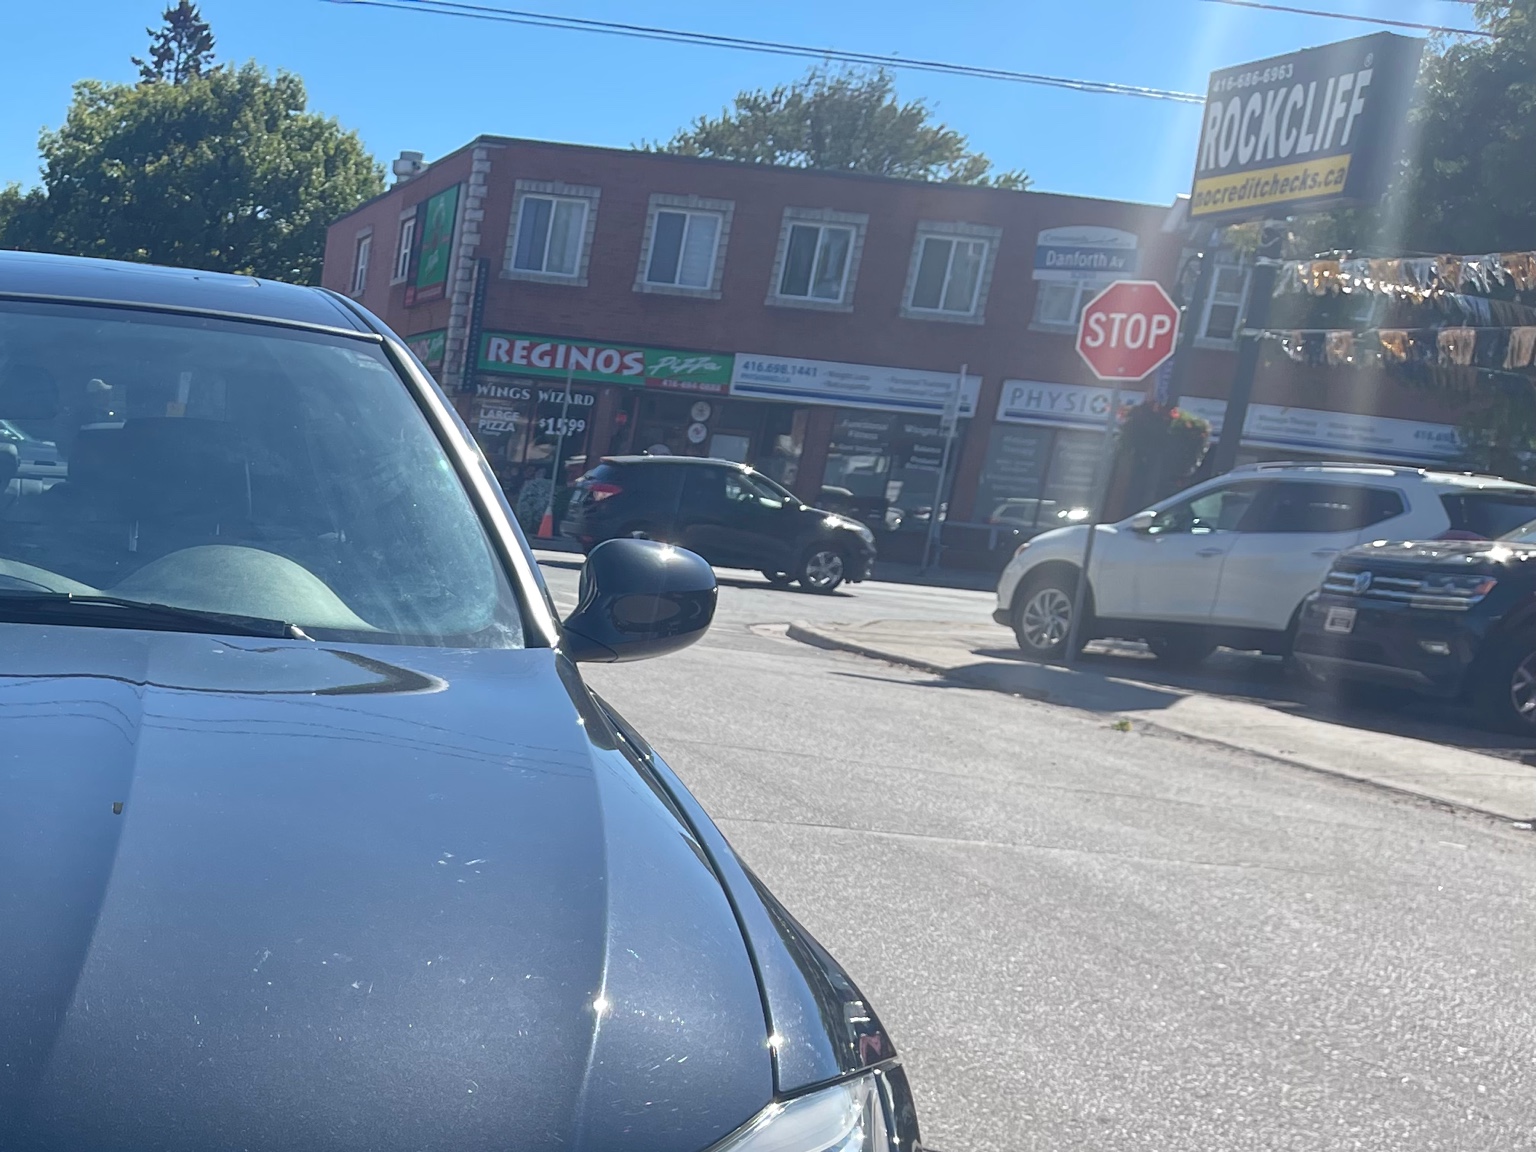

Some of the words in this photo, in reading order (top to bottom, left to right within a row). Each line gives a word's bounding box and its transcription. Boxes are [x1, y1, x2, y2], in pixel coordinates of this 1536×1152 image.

[1200, 69, 1374, 171] ROCKCLIFF
[1194, 166, 1346, 207] nocreditchecks.ca
[1045, 250, 1108, 268] Danforth
[1084, 312, 1171, 350] STOP
[486, 337, 645, 376] REGINOS
[476, 383, 531, 400] WINGS
[537, 388, 595, 406] WIZARD
[478, 419, 516, 432] PIZZA
[479, 409, 520, 421] LARGE
